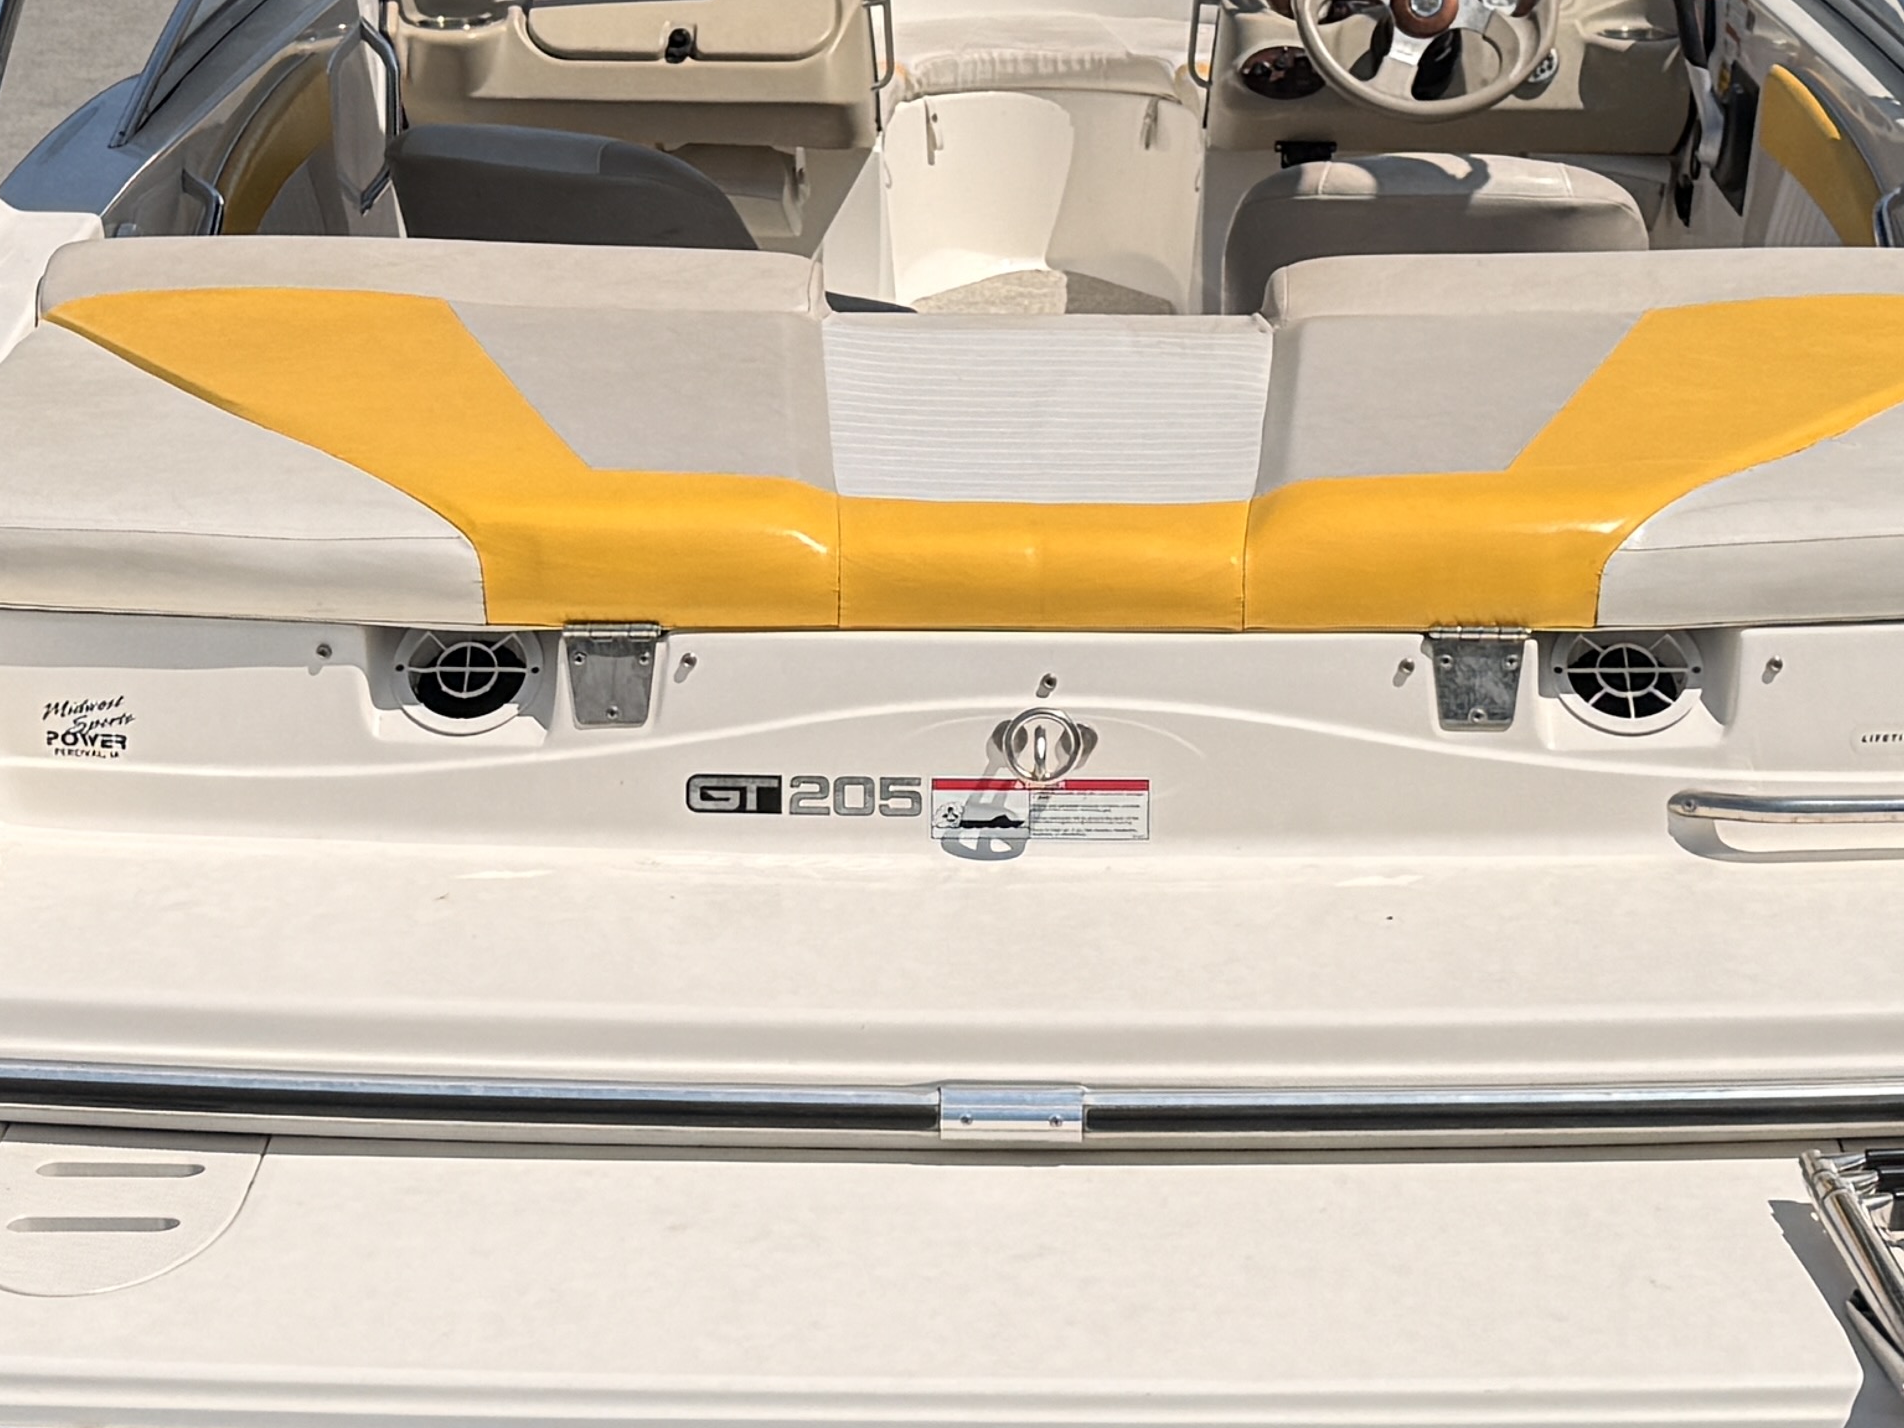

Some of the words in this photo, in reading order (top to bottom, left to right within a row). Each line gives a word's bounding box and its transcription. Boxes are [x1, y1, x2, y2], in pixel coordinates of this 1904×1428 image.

[42, 695, 124, 720] Midwest
[68, 713, 136, 735] Sports
[46, 730, 127, 750] POWER
[687, 775, 780, 813] GT
[788, 775, 923, 817] 205
